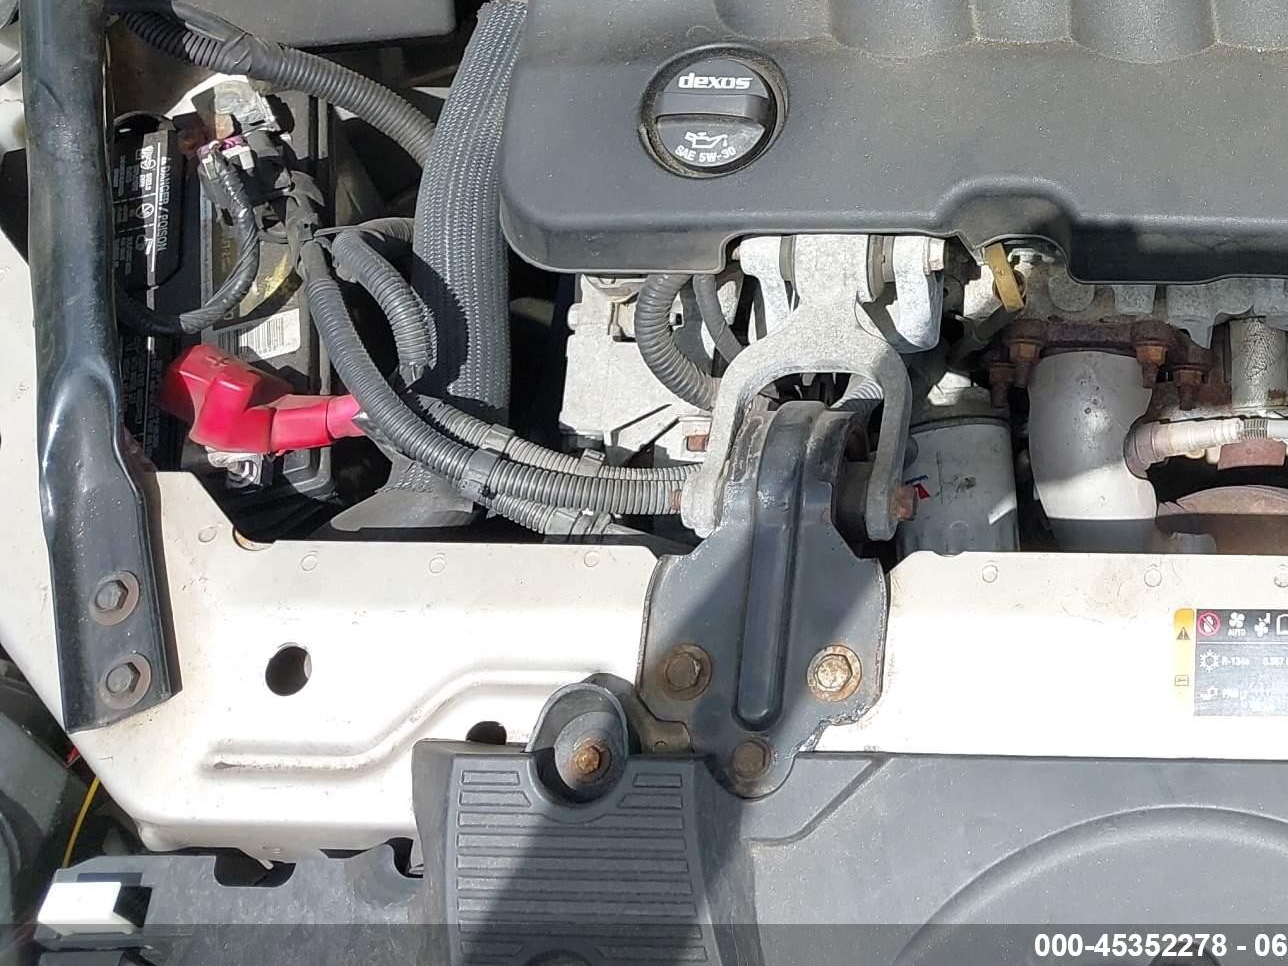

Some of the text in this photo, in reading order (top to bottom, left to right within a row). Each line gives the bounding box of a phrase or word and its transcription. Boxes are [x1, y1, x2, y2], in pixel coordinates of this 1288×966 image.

[678, 72, 753, 90] dexos
[674, 145, 737, 163] SAE 5W-30
[157, 214, 169, 251] POISON
